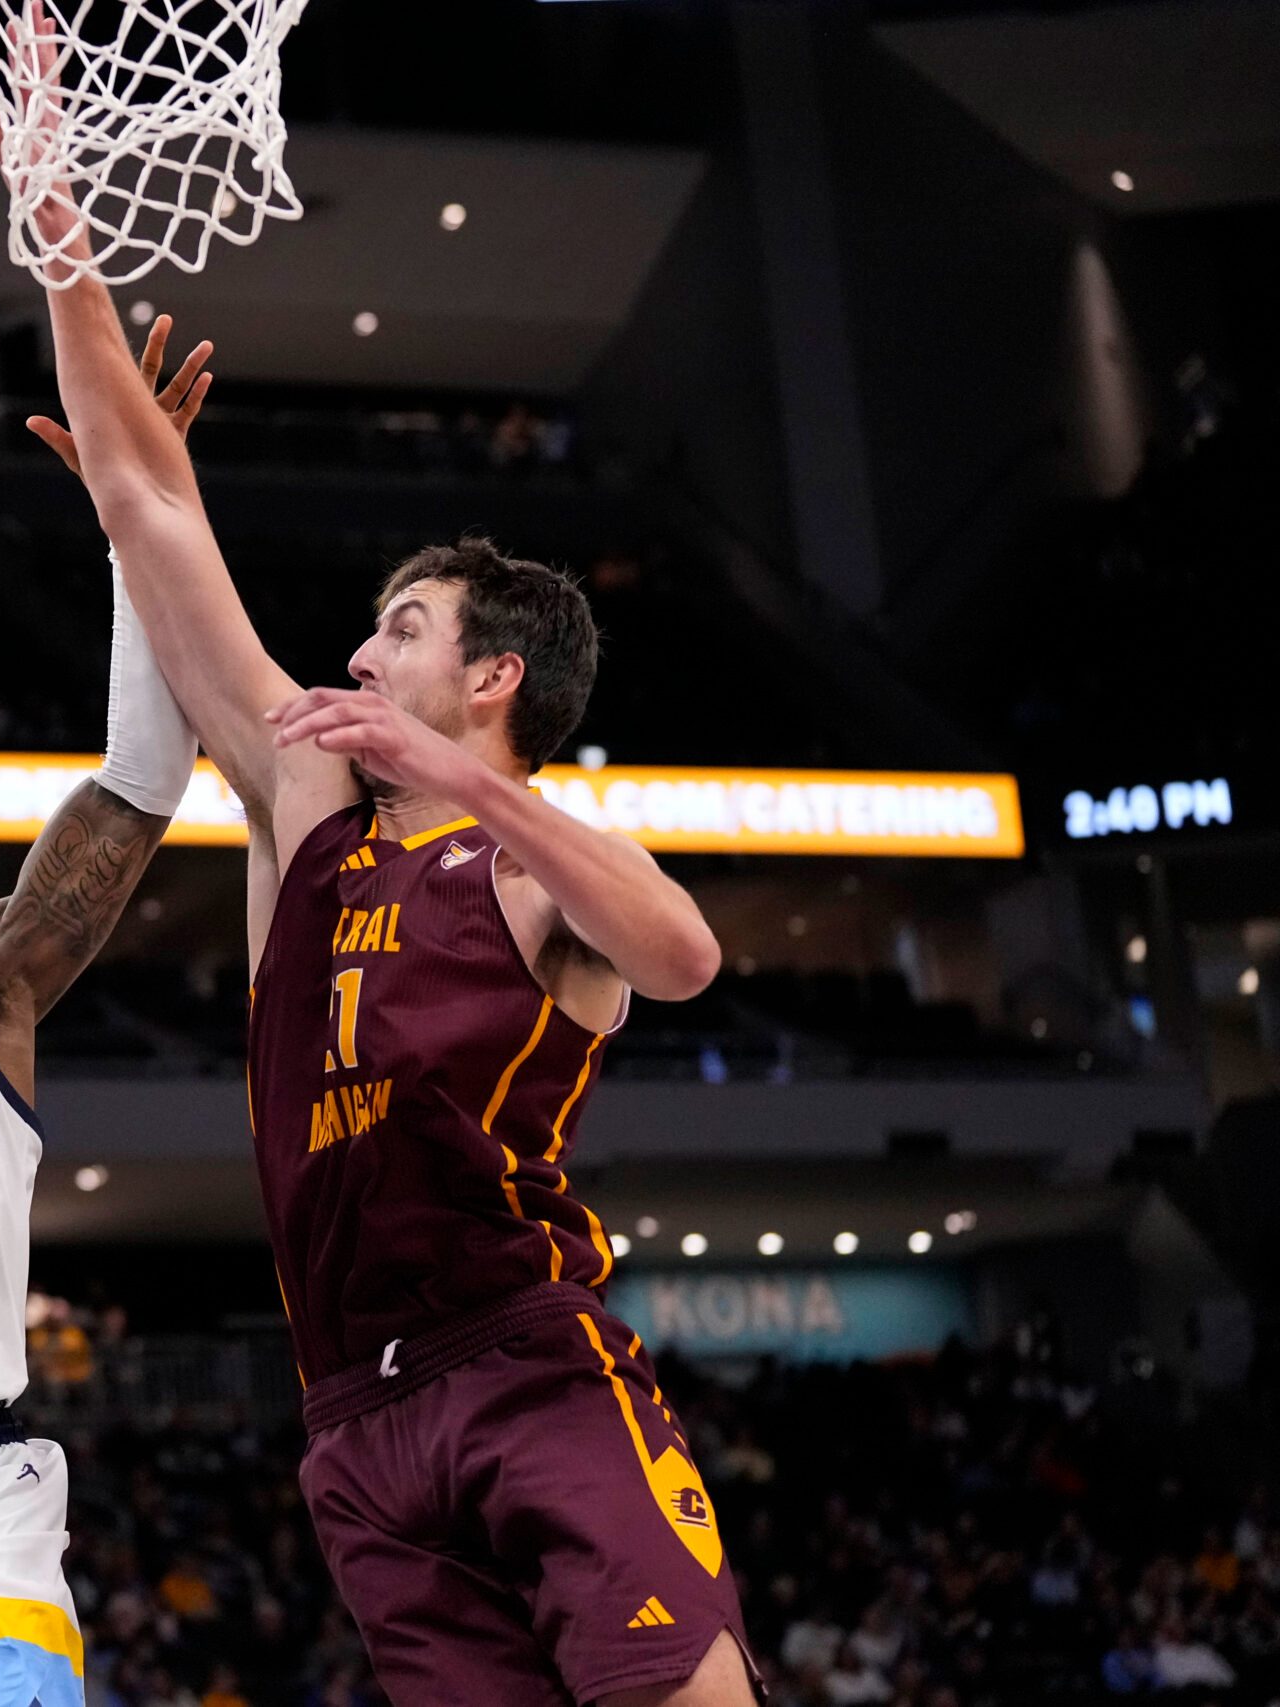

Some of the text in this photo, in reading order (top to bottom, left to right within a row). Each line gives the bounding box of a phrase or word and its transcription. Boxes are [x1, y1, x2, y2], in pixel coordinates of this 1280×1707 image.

[1063, 777, 1233, 838] 2:40 PM
[325, 967, 363, 1072] 1
[649, 1273, 843, 1338] KONA
